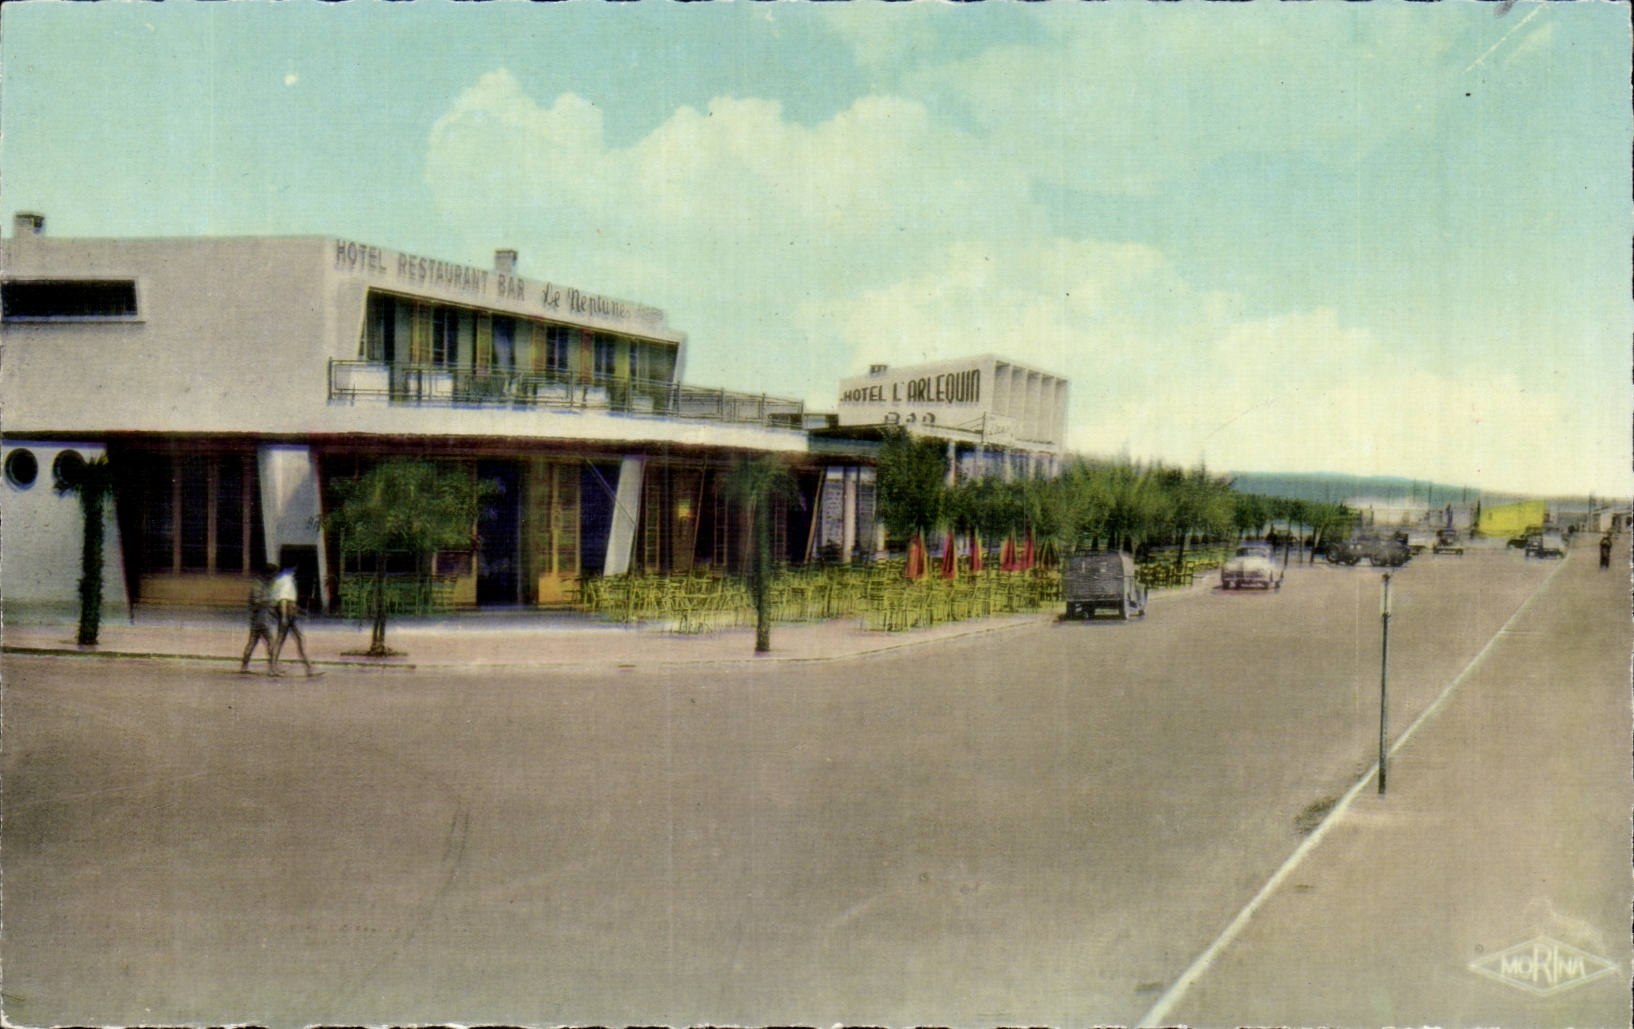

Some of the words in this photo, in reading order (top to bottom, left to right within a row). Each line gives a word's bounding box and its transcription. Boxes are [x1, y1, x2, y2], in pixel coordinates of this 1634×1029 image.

[335, 239, 387, 273] HOTEL
[397, 252, 489, 292] RESTAURANT
[498, 273, 525, 302] BAR
[541, 281, 561, 309] Le
[843, 384, 887, 401] HOTEL
